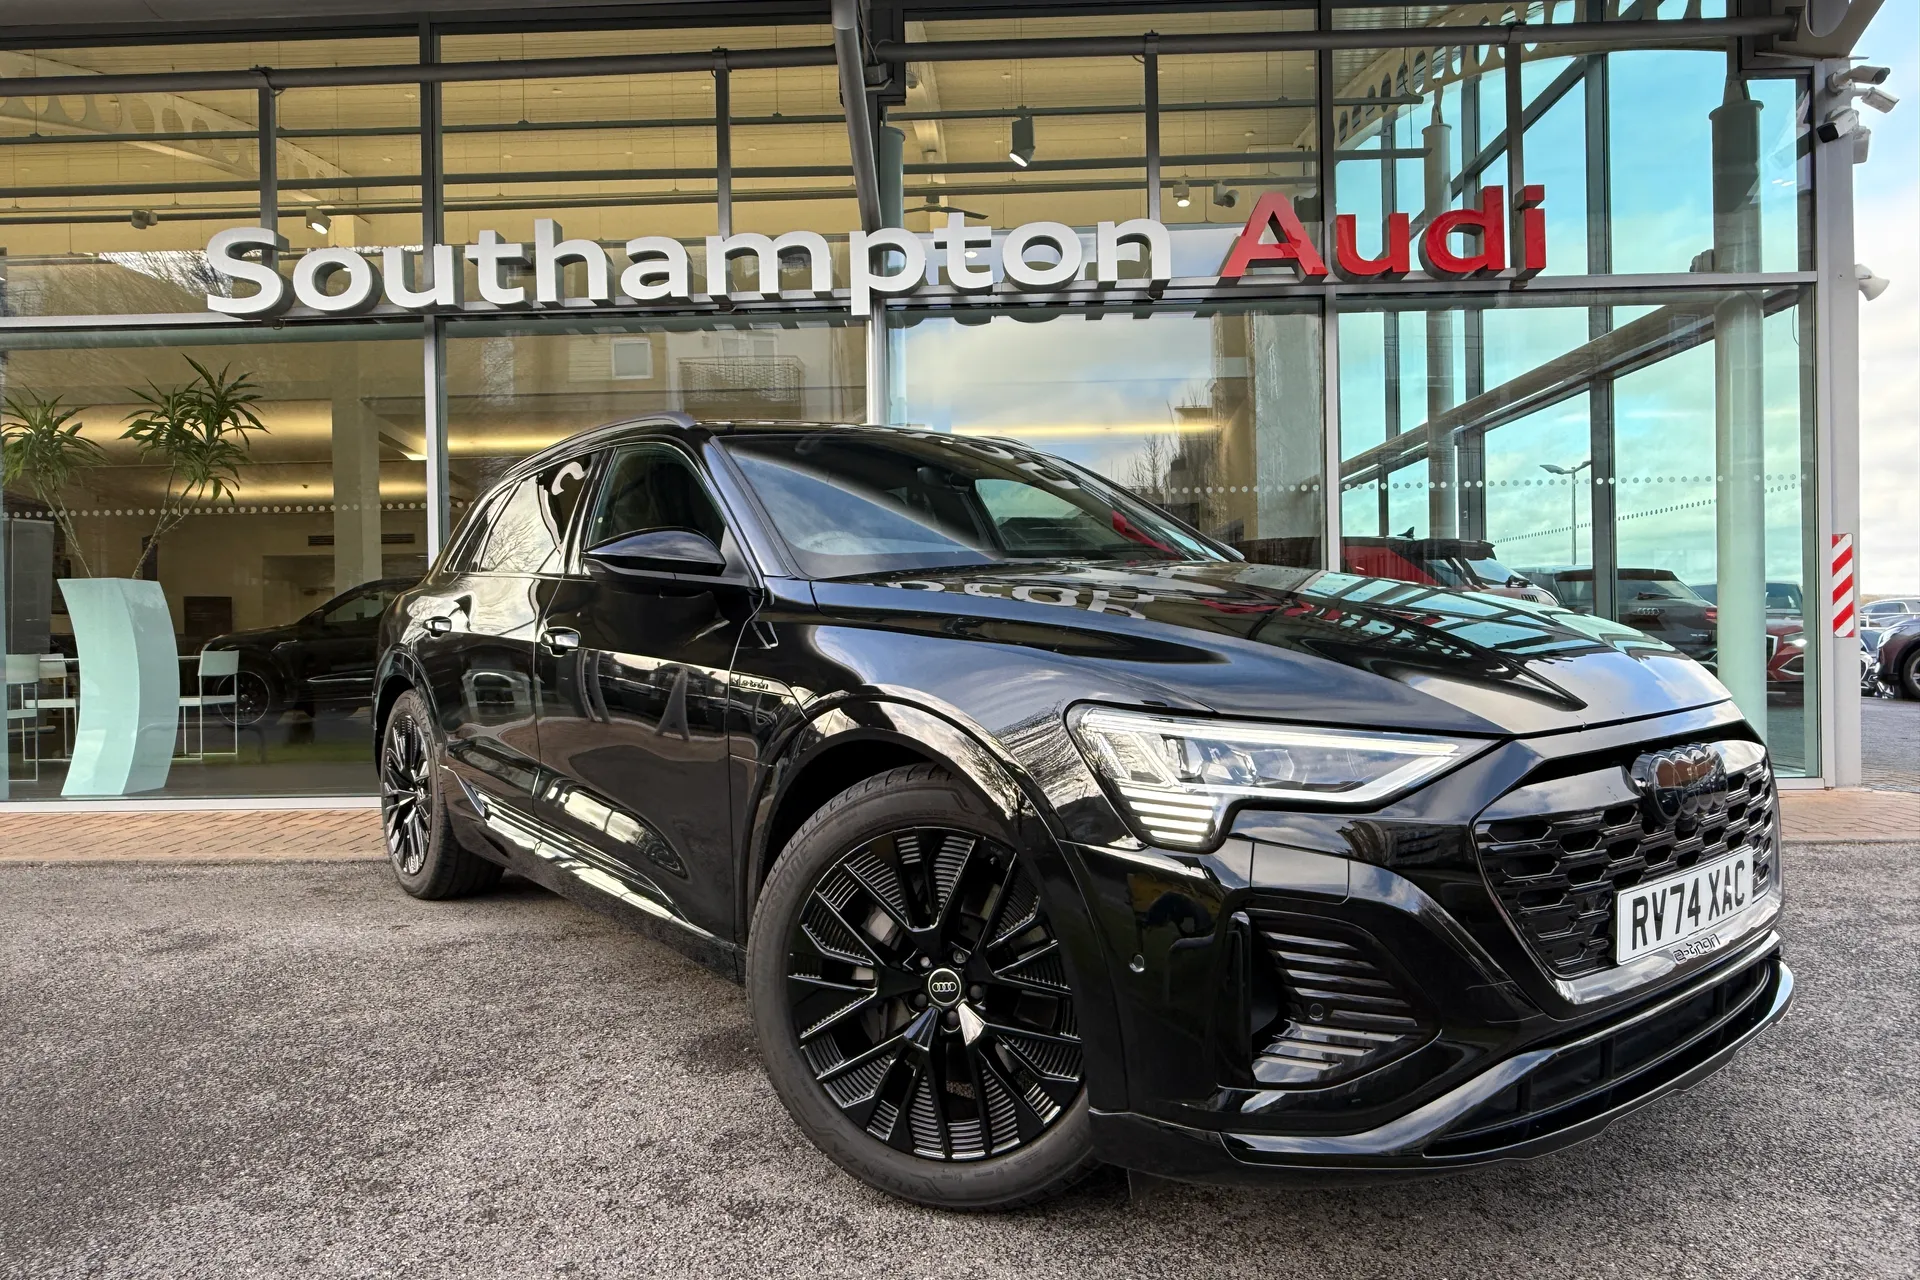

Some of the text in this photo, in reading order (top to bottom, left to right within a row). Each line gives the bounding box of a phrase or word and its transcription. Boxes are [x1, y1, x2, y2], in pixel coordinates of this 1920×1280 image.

[206, 185, 1547, 316] Southampton Audi
[1632, 859, 1746, 951] RV74 XAC
[1672, 933, 1721, 962] e-tron
